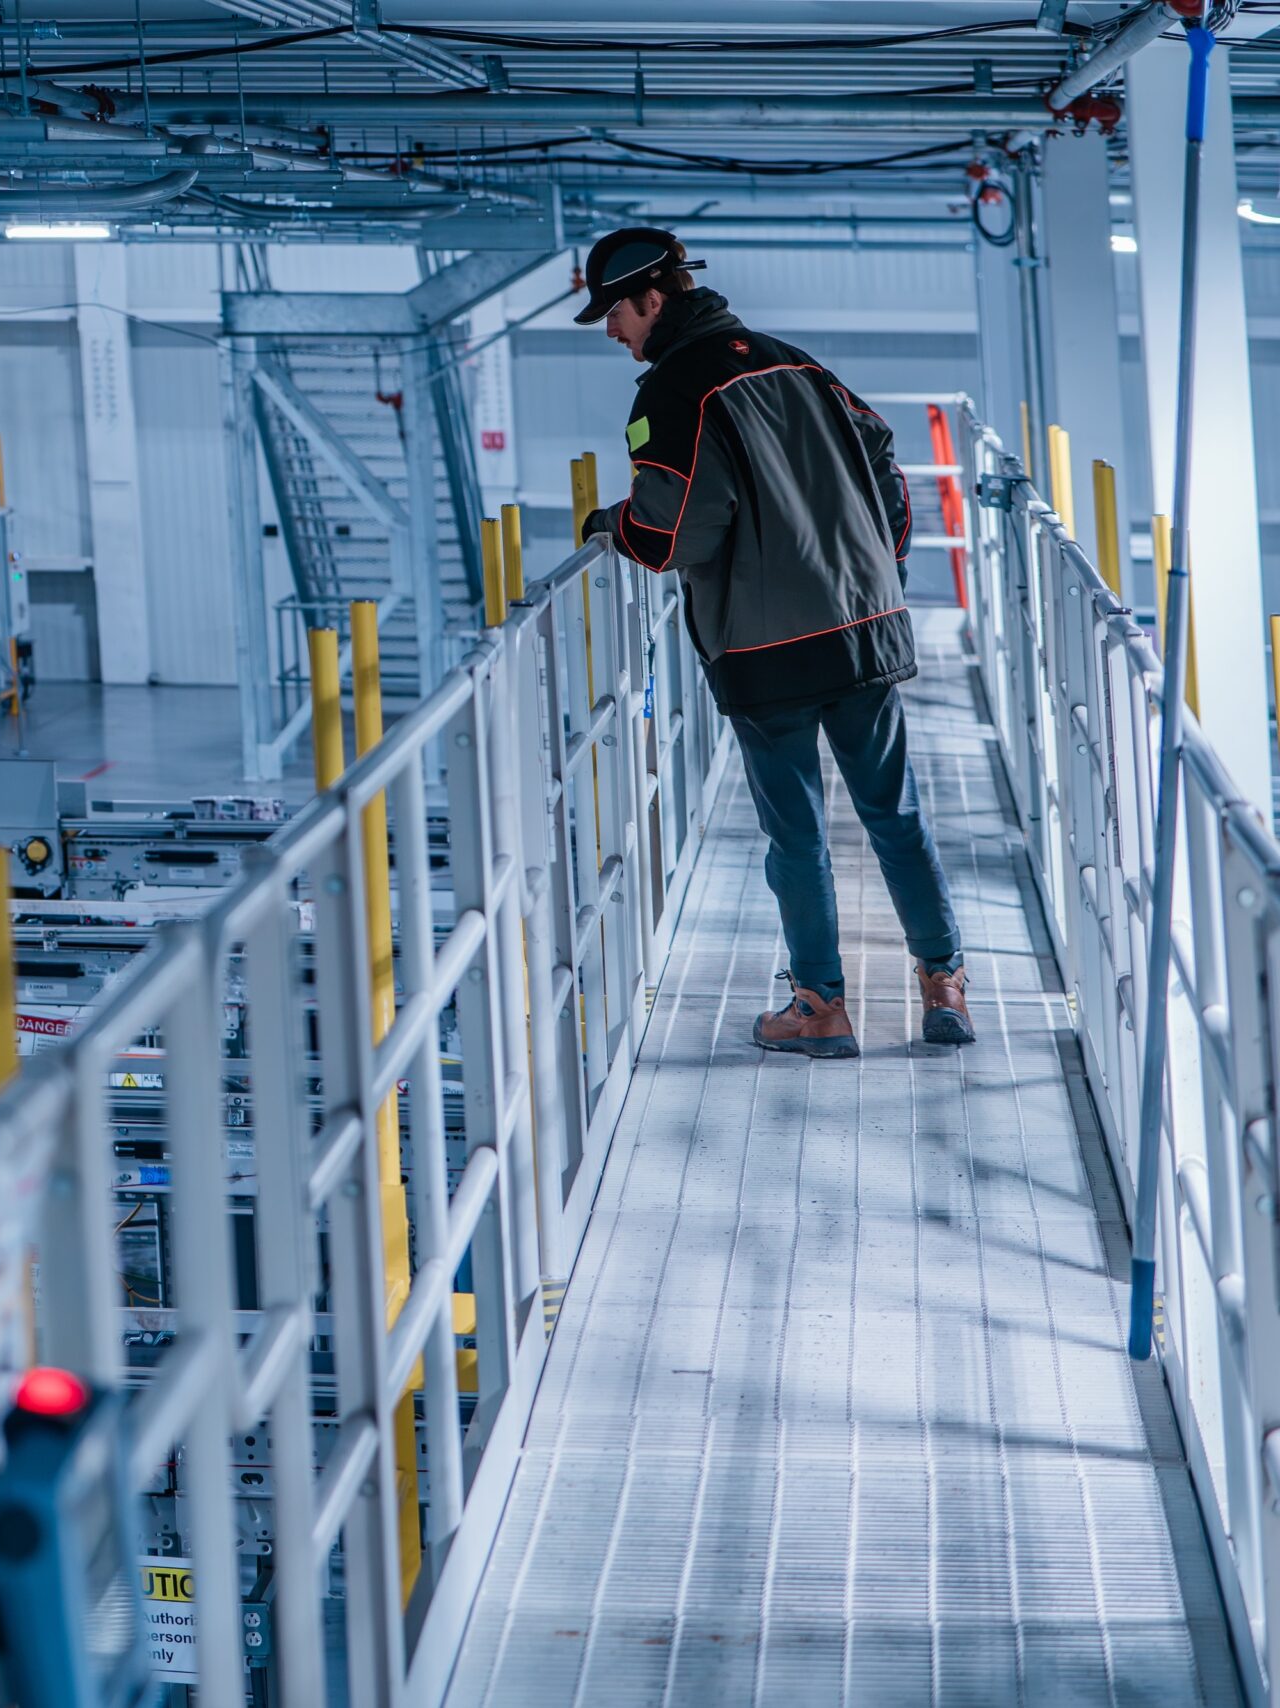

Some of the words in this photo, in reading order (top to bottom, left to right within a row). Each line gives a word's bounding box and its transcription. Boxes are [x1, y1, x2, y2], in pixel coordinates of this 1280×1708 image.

[16, 1017, 73, 1036] DANGER
[141, 1572, 195, 1598] UTIO
[144, 1612, 197, 1626] uthori
[147, 1631, 197, 1645] erson
[149, 1648, 174, 1663] nly
